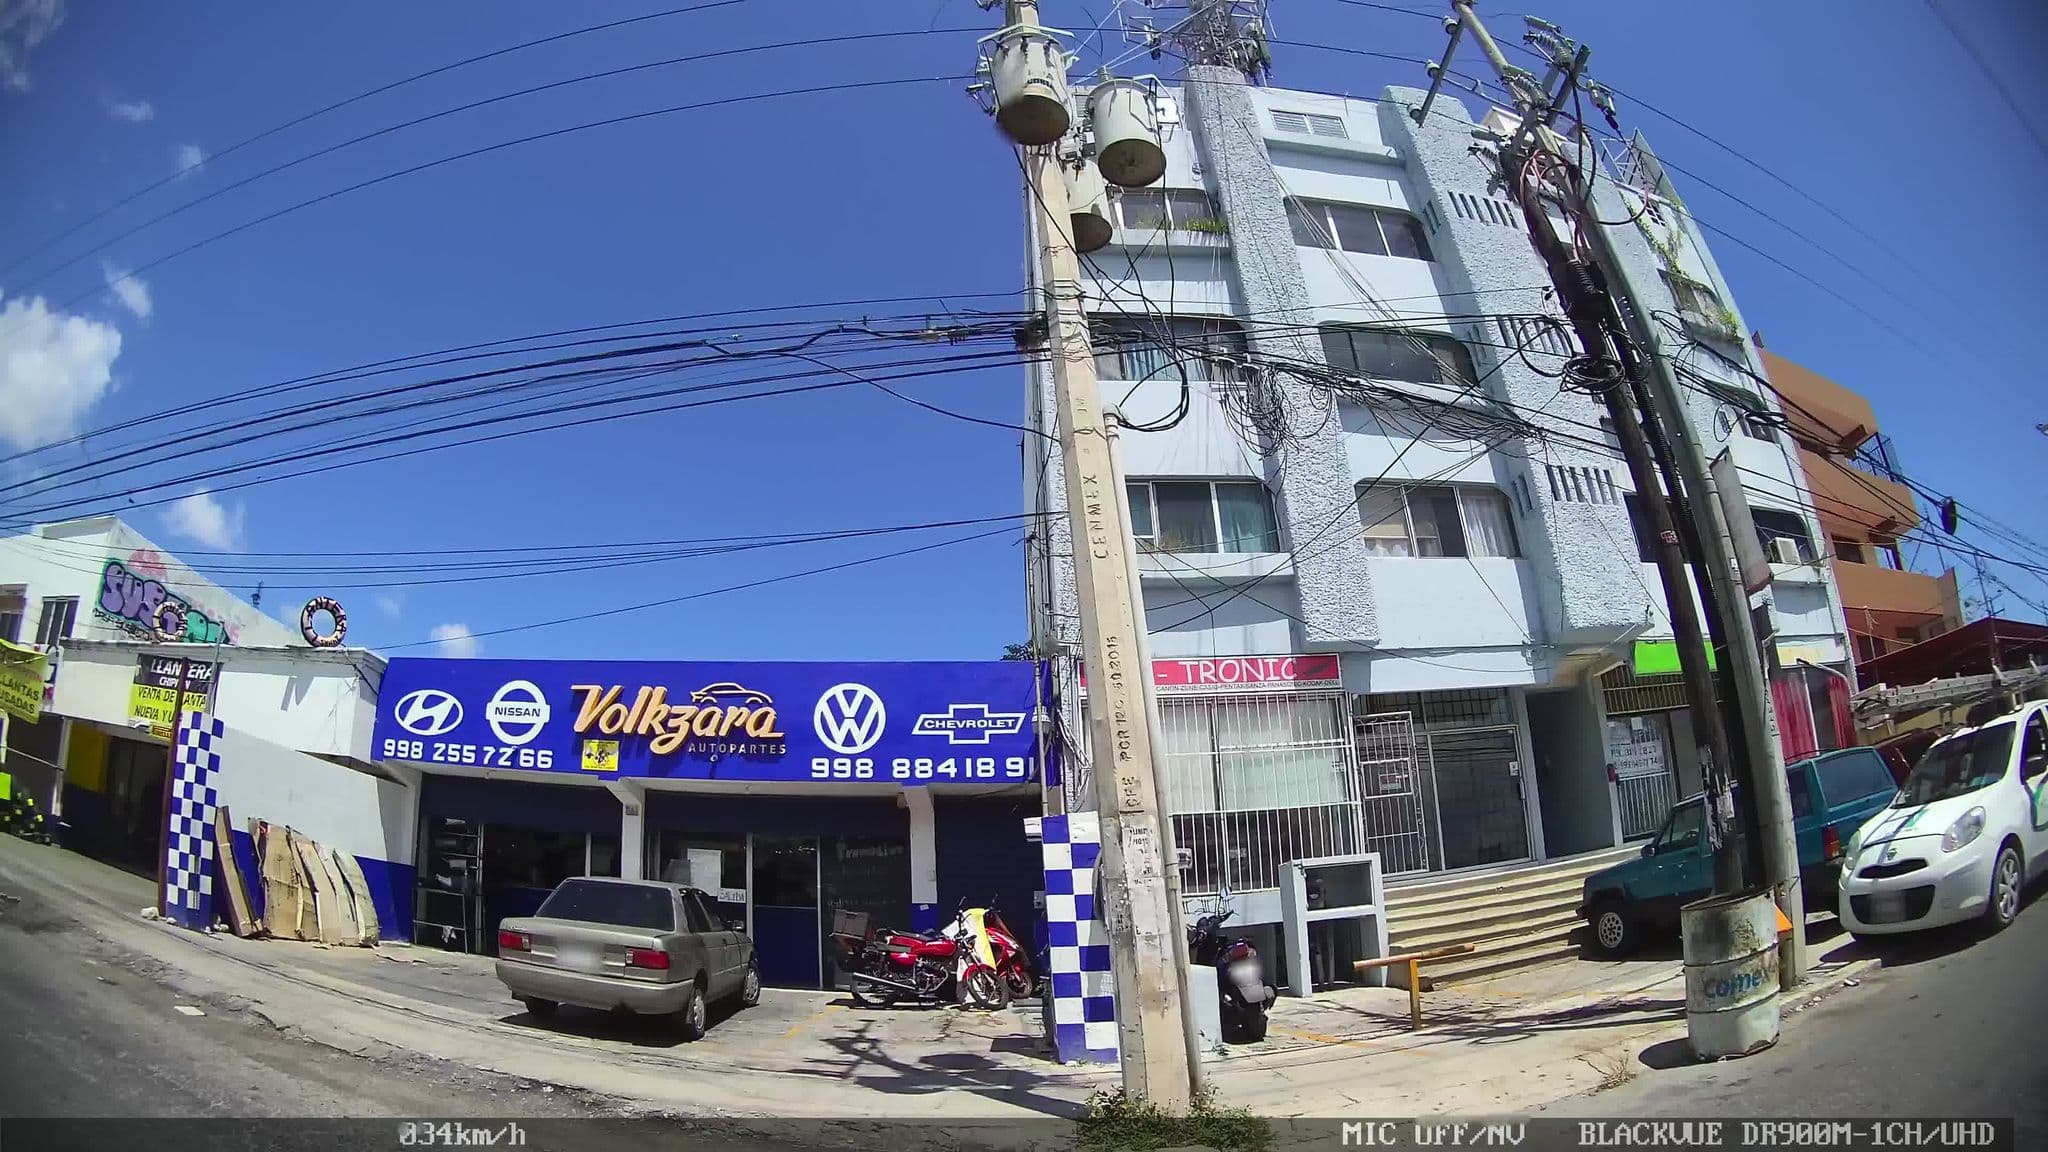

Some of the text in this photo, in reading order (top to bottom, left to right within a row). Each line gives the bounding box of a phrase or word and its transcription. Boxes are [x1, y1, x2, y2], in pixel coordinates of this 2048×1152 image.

[151, 659, 212, 680] LLANERA
[1178, 657, 1297, 684] TRONIC
[138, 687, 160, 701] VENTA
[164, 690, 175, 703] DE
[135, 705, 159, 721] NUEVA
[494, 706, 541, 718] NISSAN
[570, 684, 785, 755] Volkzara
[924, 718, 1016, 730] CHEVROLET
[383, 738, 424, 759] 998
[433, 743, 477, 764] 255
[688, 742, 787, 755] AUTOPARTES
[811, 757, 875, 779] 998
